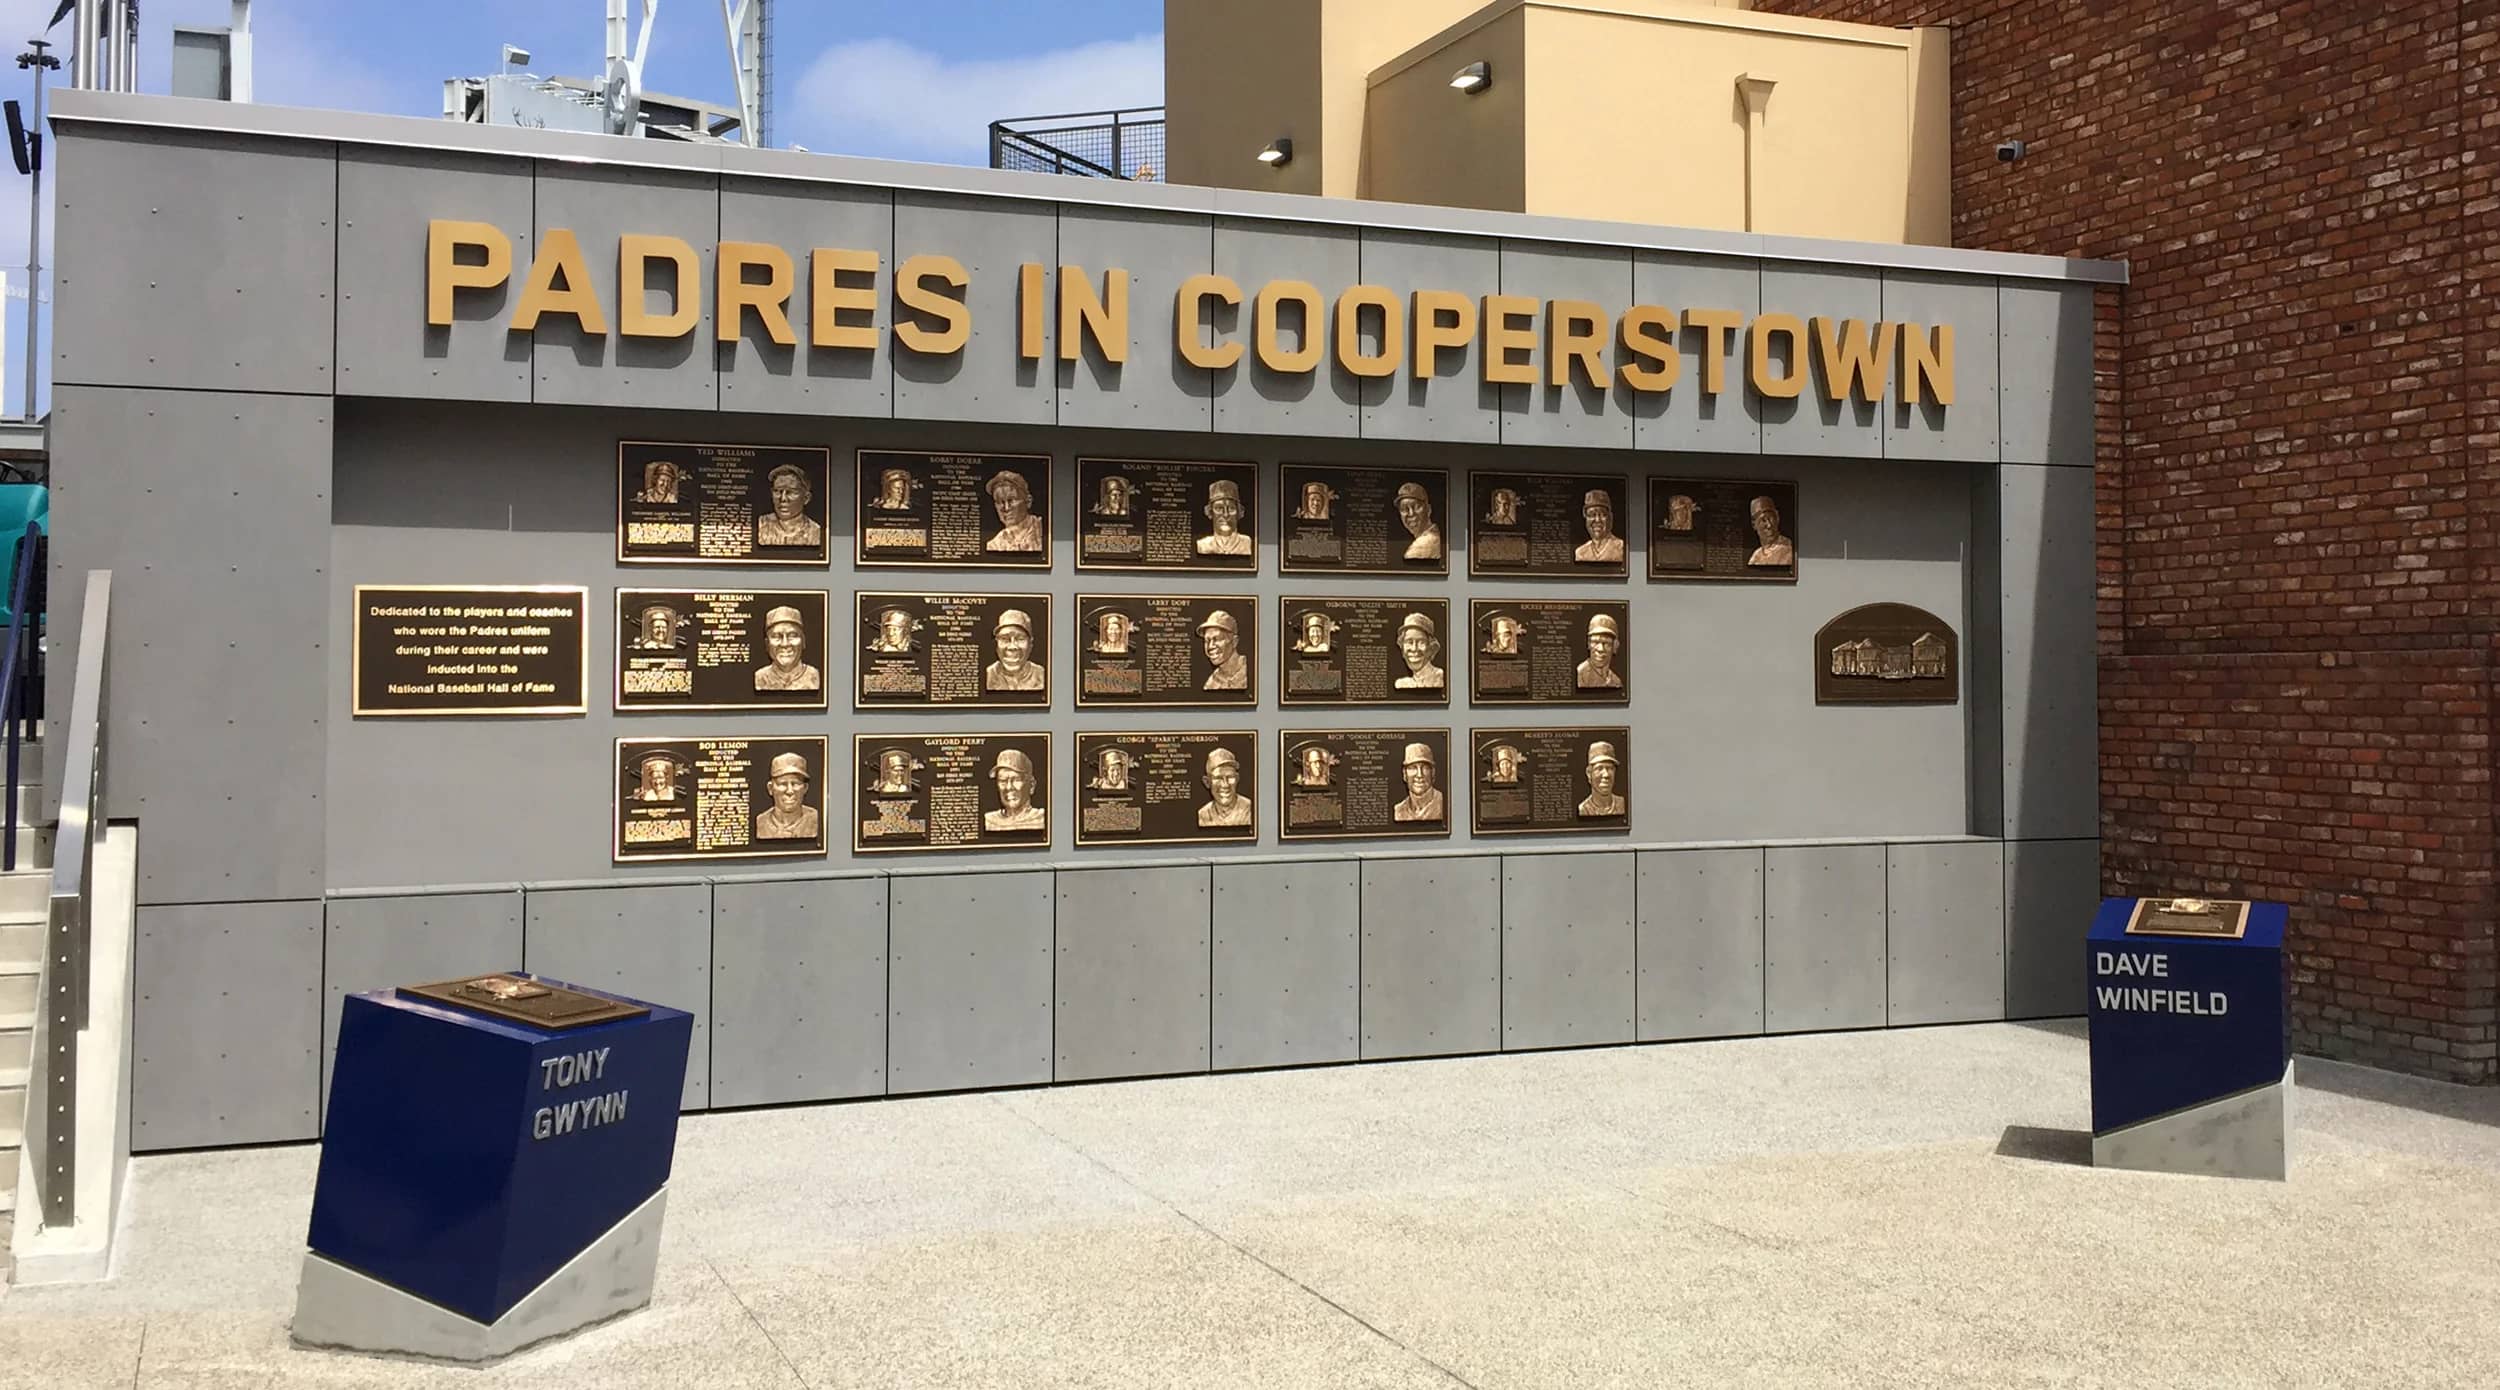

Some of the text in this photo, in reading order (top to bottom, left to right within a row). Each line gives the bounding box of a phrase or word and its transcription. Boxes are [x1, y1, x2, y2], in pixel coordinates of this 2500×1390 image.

[428, 218, 1954, 406] PADRES IN COOPERSTOWN
[719, 594, 754, 602] HERMAN
[370, 606, 574, 619] Dedicated to the players and coaches
[393, 625, 551, 637] who wore the Padres uniform
[395, 644, 549, 657] during their career and were
[426, 663, 519, 674] inducted into the
[388, 681, 556, 694] National Baseball Hall of Fame
[699, 742, 717, 750] BOB
[2096, 951, 2169, 978] DAVE
[2095, 986, 2229, 1017] WINFIELD
[541, 1047, 611, 1090] TONY
[532, 1089, 629, 1141] GWYNN
